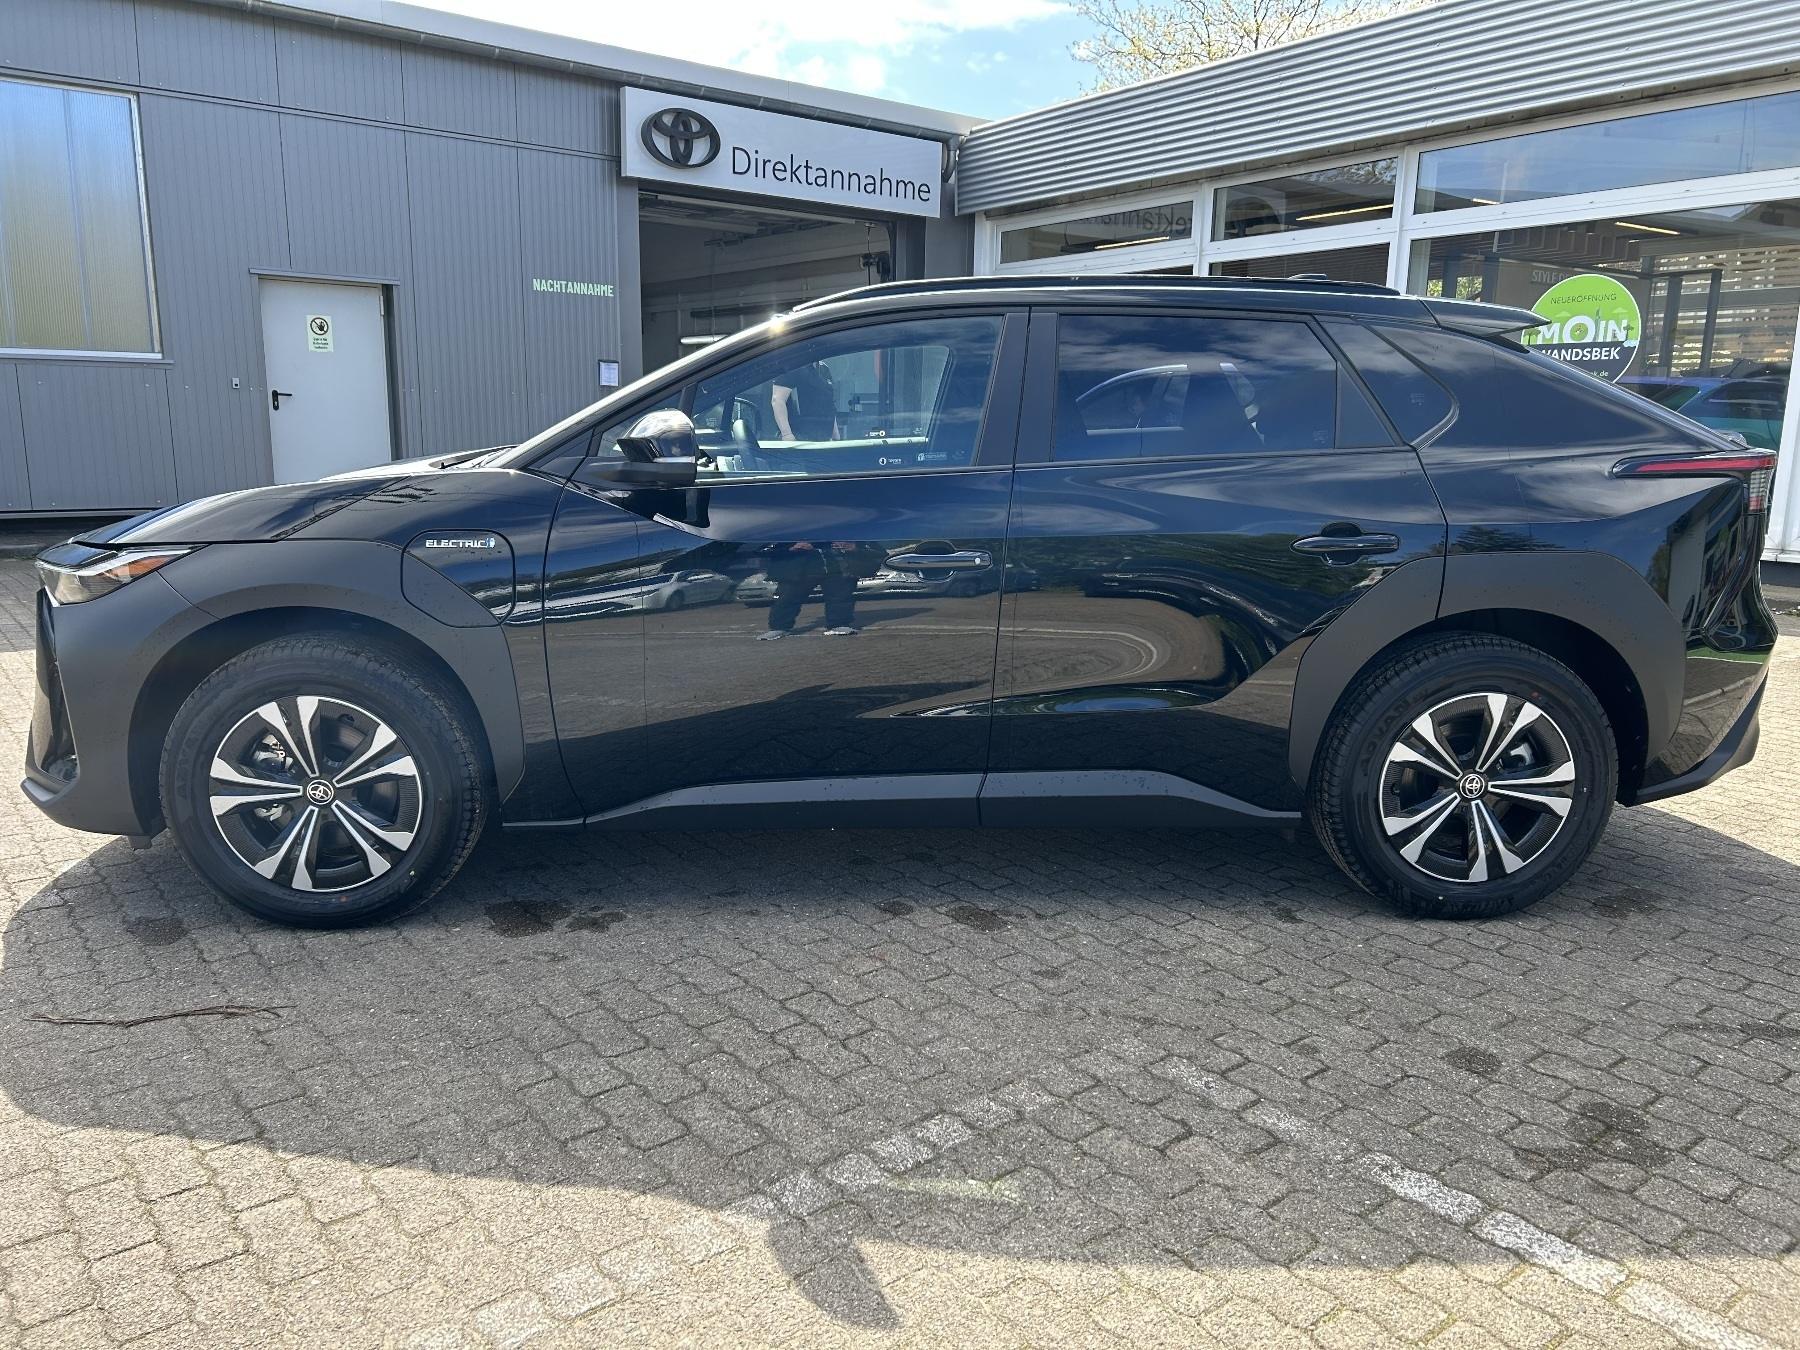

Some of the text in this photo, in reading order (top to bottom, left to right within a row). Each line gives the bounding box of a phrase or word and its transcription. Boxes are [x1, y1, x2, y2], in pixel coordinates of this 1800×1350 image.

[732, 146, 931, 202] Direktannahme
[533, 278, 614, 297] NACHTANNAHME
[1537, 315, 1628, 343] MOIN
[425, 539, 487, 548] ELECTRIC
